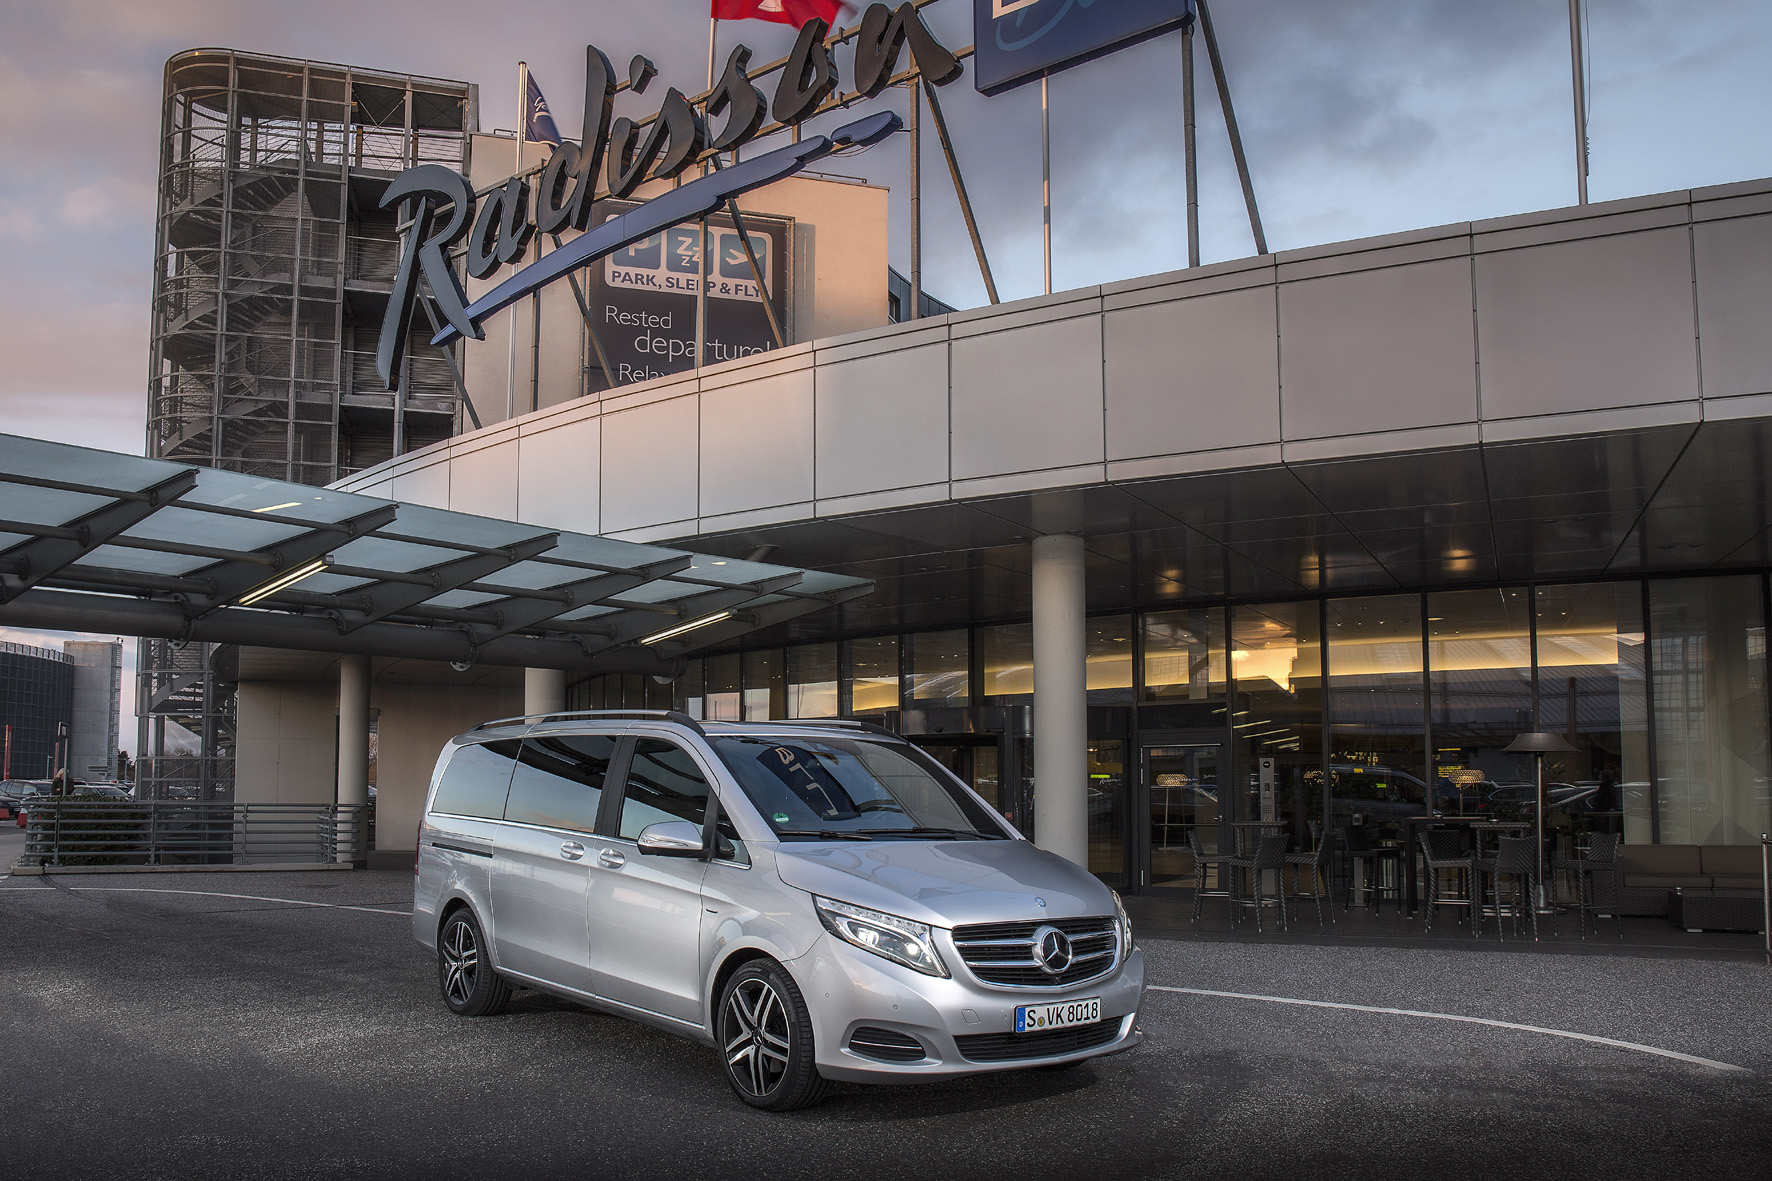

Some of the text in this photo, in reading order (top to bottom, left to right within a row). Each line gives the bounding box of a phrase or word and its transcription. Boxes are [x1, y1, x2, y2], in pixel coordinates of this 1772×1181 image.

[376, 2, 964, 391] Radisson
[611, 270, 761, 298] PARK, SLEP & FLY
[605, 305, 672, 329] Rested
[634, 329, 770, 363] depature!
[619, 363, 673, 383] Rela
[1027, 1001, 1098, 1027] S VK 8018
